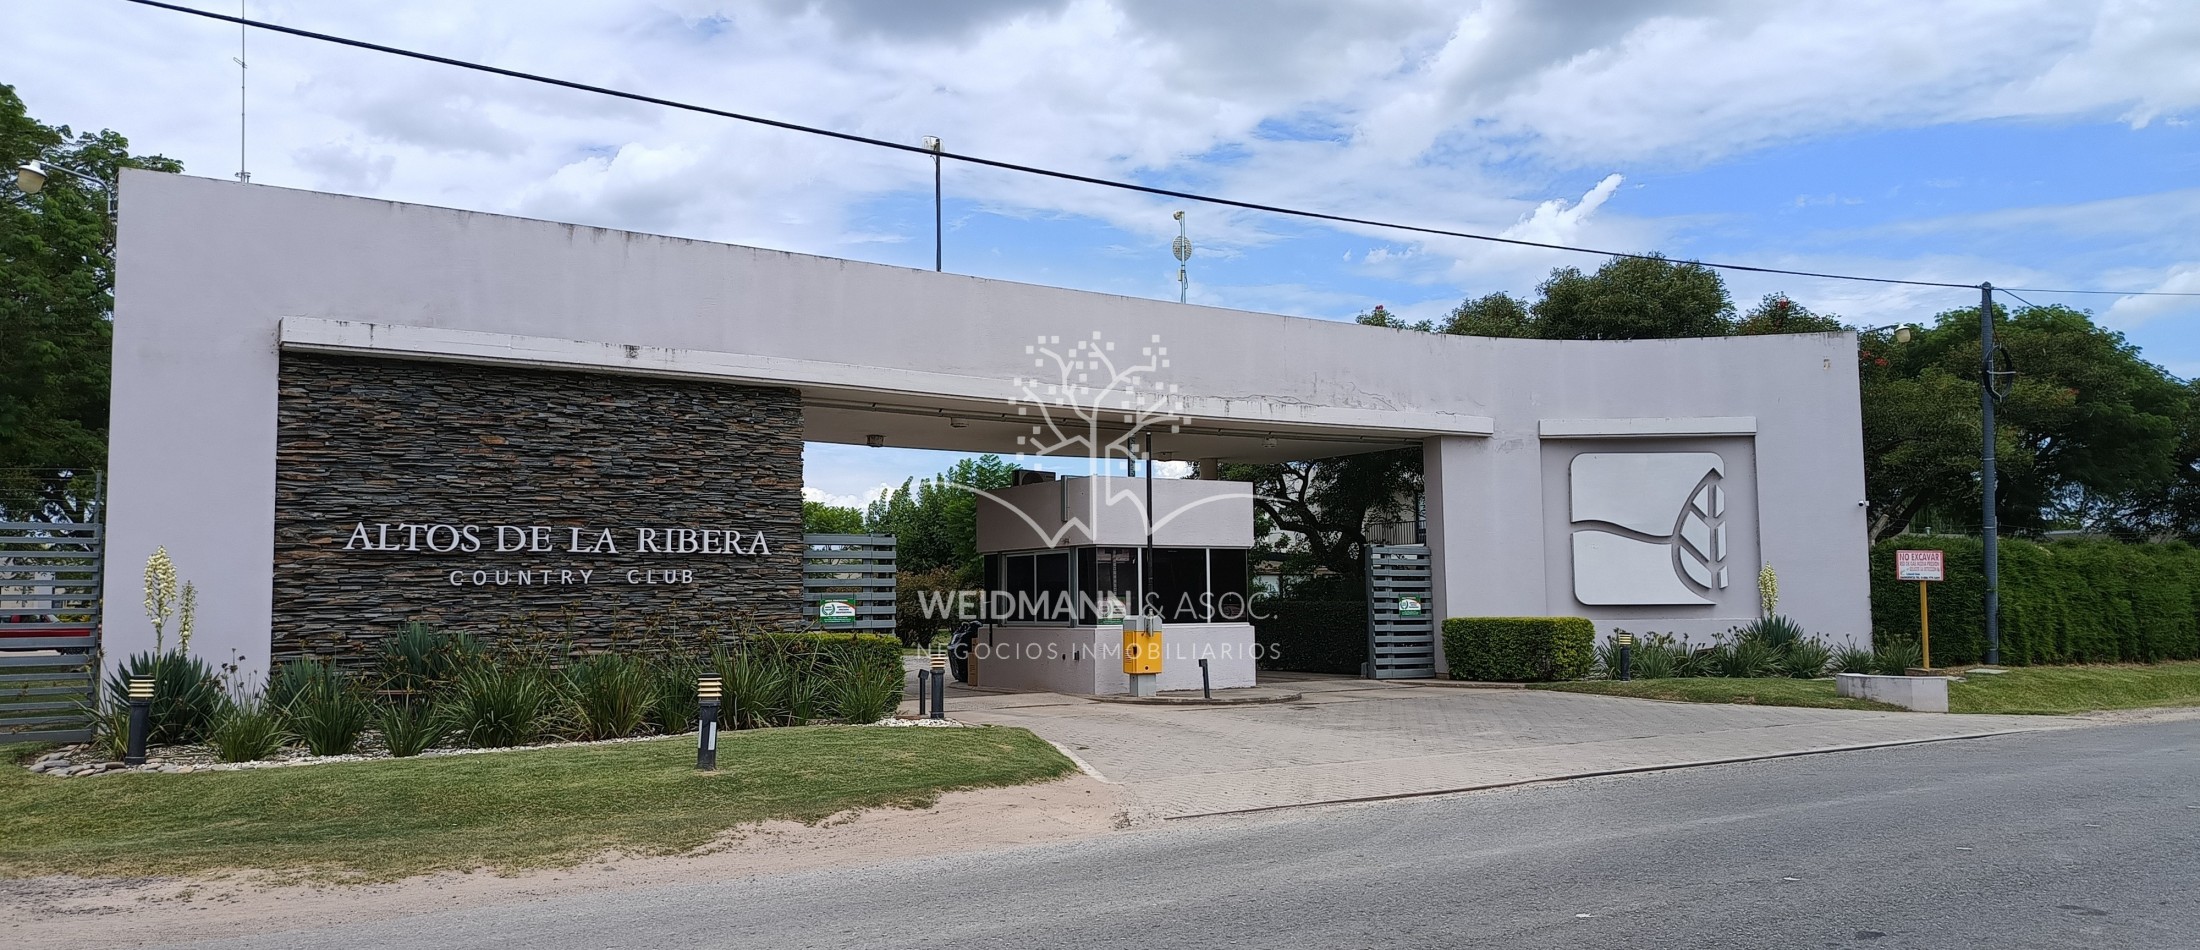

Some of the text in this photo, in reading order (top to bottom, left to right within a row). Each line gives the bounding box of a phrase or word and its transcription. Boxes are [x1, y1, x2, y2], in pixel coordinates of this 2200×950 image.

[343, 521, 772, 556] ALTOS DE LA RIBERA
[450, 569, 694, 587] COUNTRY CLUB
